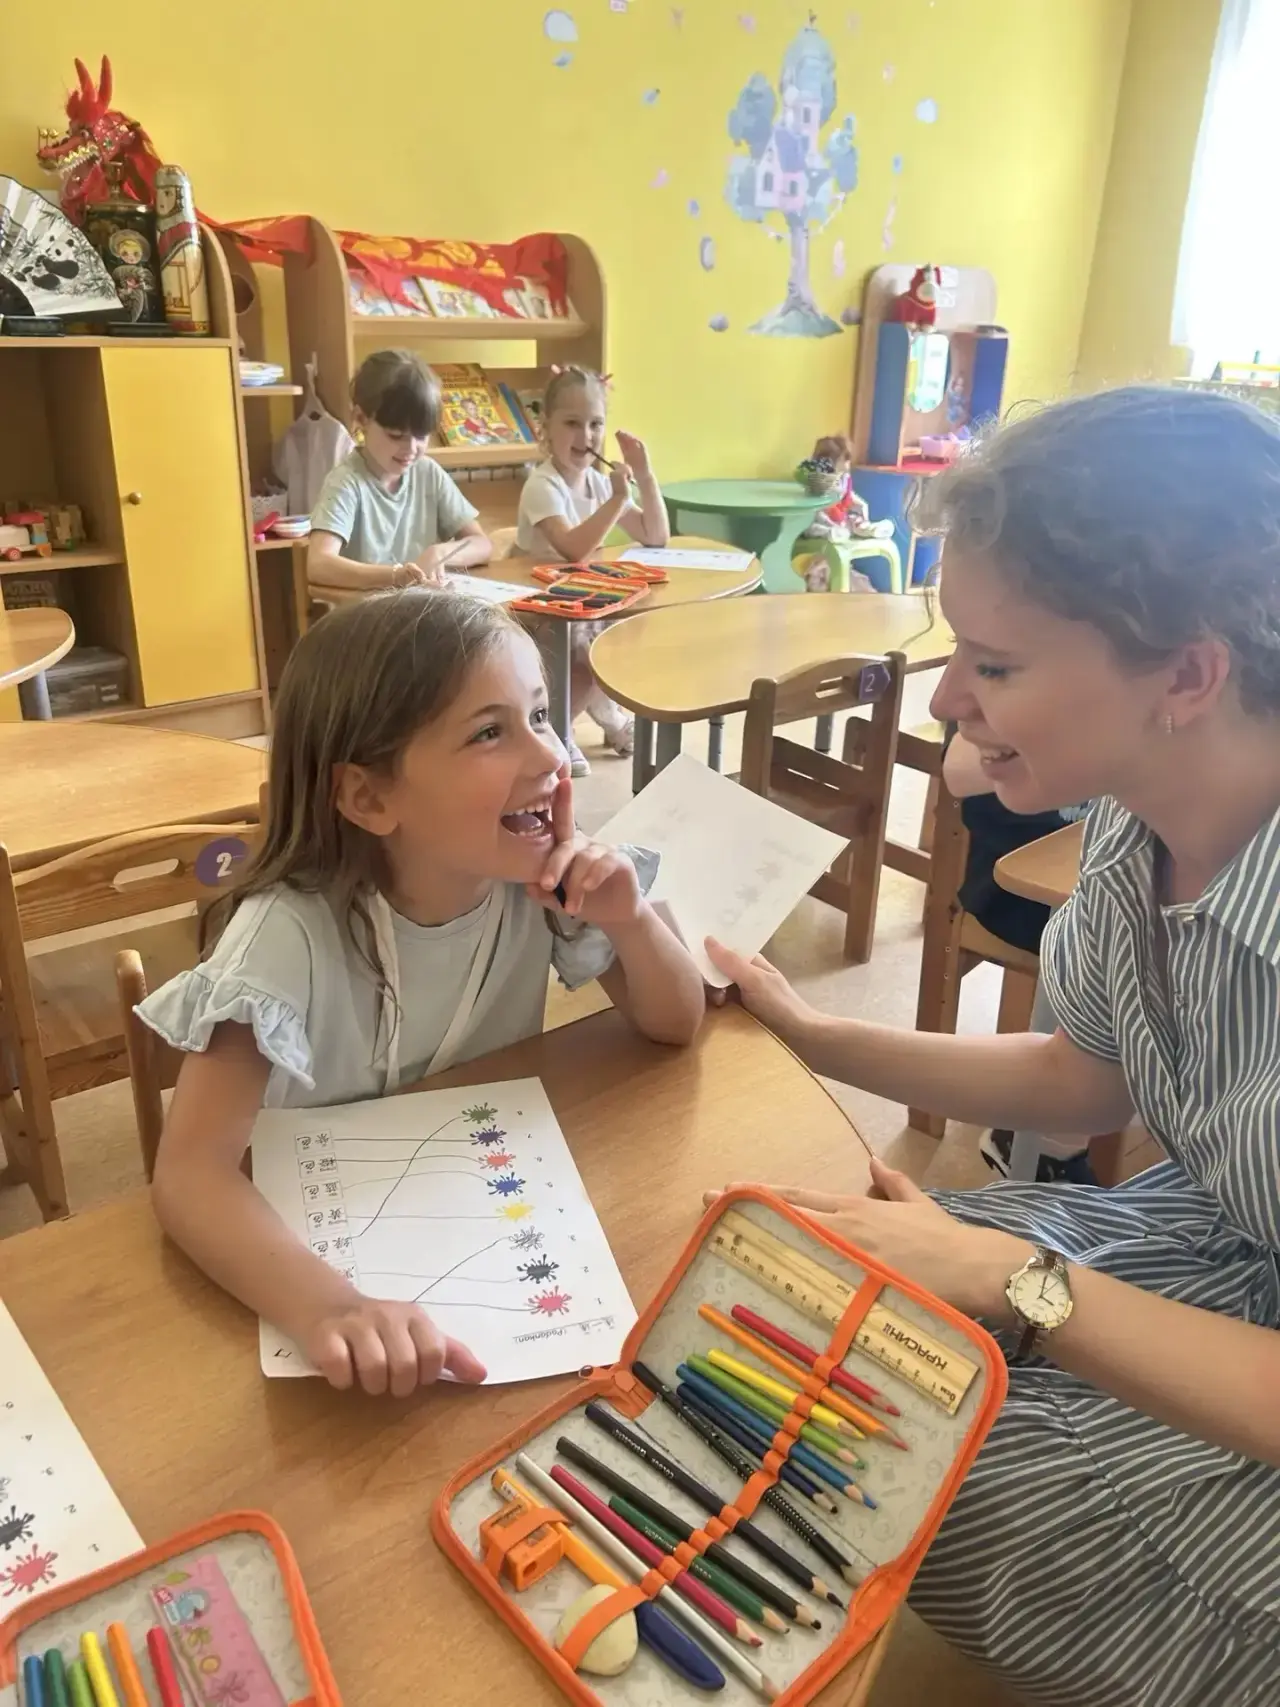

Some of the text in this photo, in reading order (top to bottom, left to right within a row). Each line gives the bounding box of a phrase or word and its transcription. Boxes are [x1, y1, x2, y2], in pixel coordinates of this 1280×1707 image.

[865, 672, 876, 693] 2
[216, 852, 233, 878] 2
[513, 1328, 568, 1344] (Padankan)
[889, 1325, 948, 1371] КРАСИН
